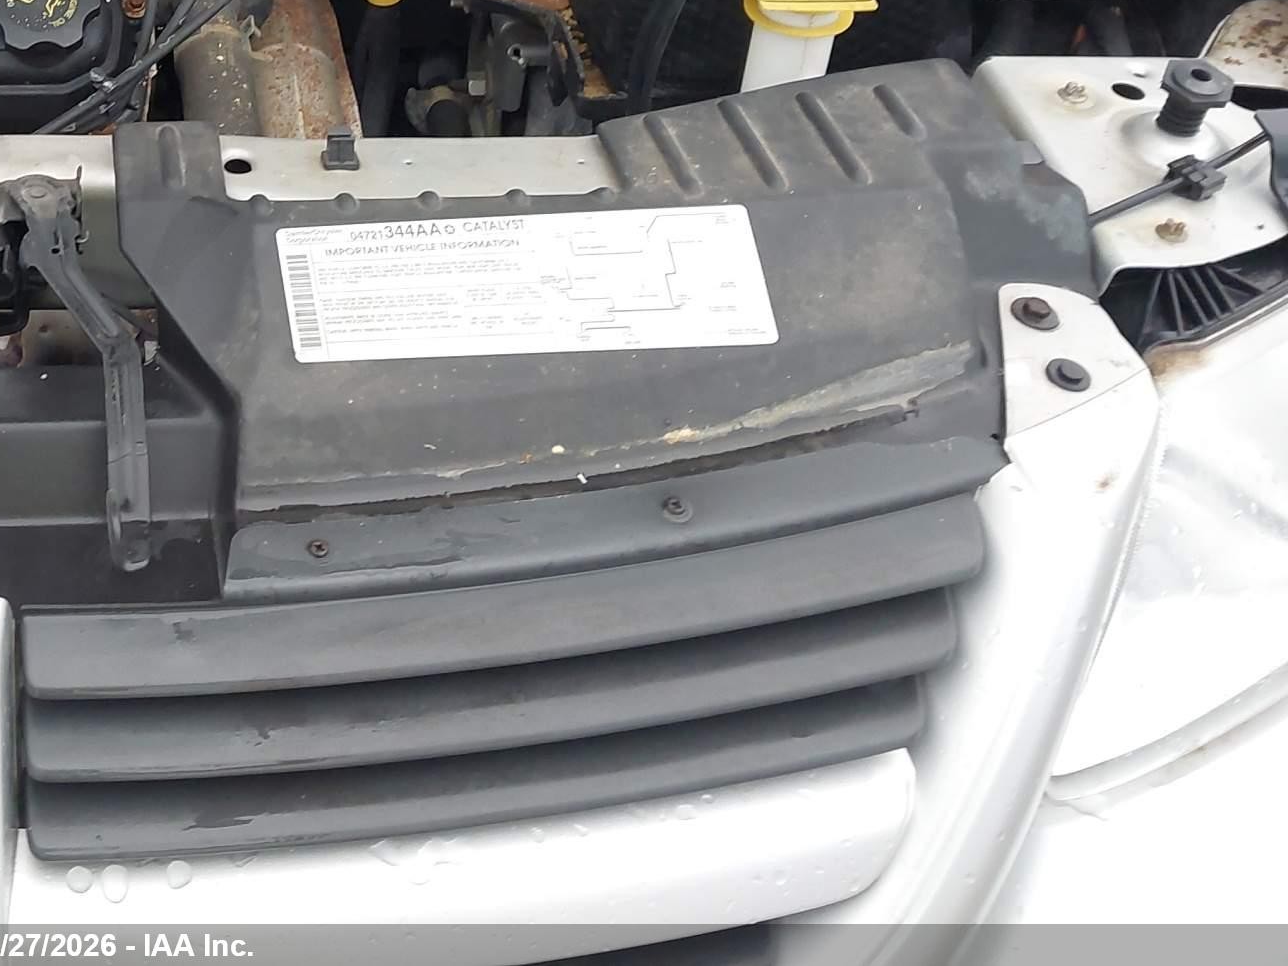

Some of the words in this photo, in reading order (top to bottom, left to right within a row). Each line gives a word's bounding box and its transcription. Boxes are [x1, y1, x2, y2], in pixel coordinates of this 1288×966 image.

[462, 219, 525, 232] CATALYST
[325, 245, 389, 257] IMPORTANT
[393, 242, 436, 253] VEHICLE
[440, 239, 520, 250] INFORMATION
